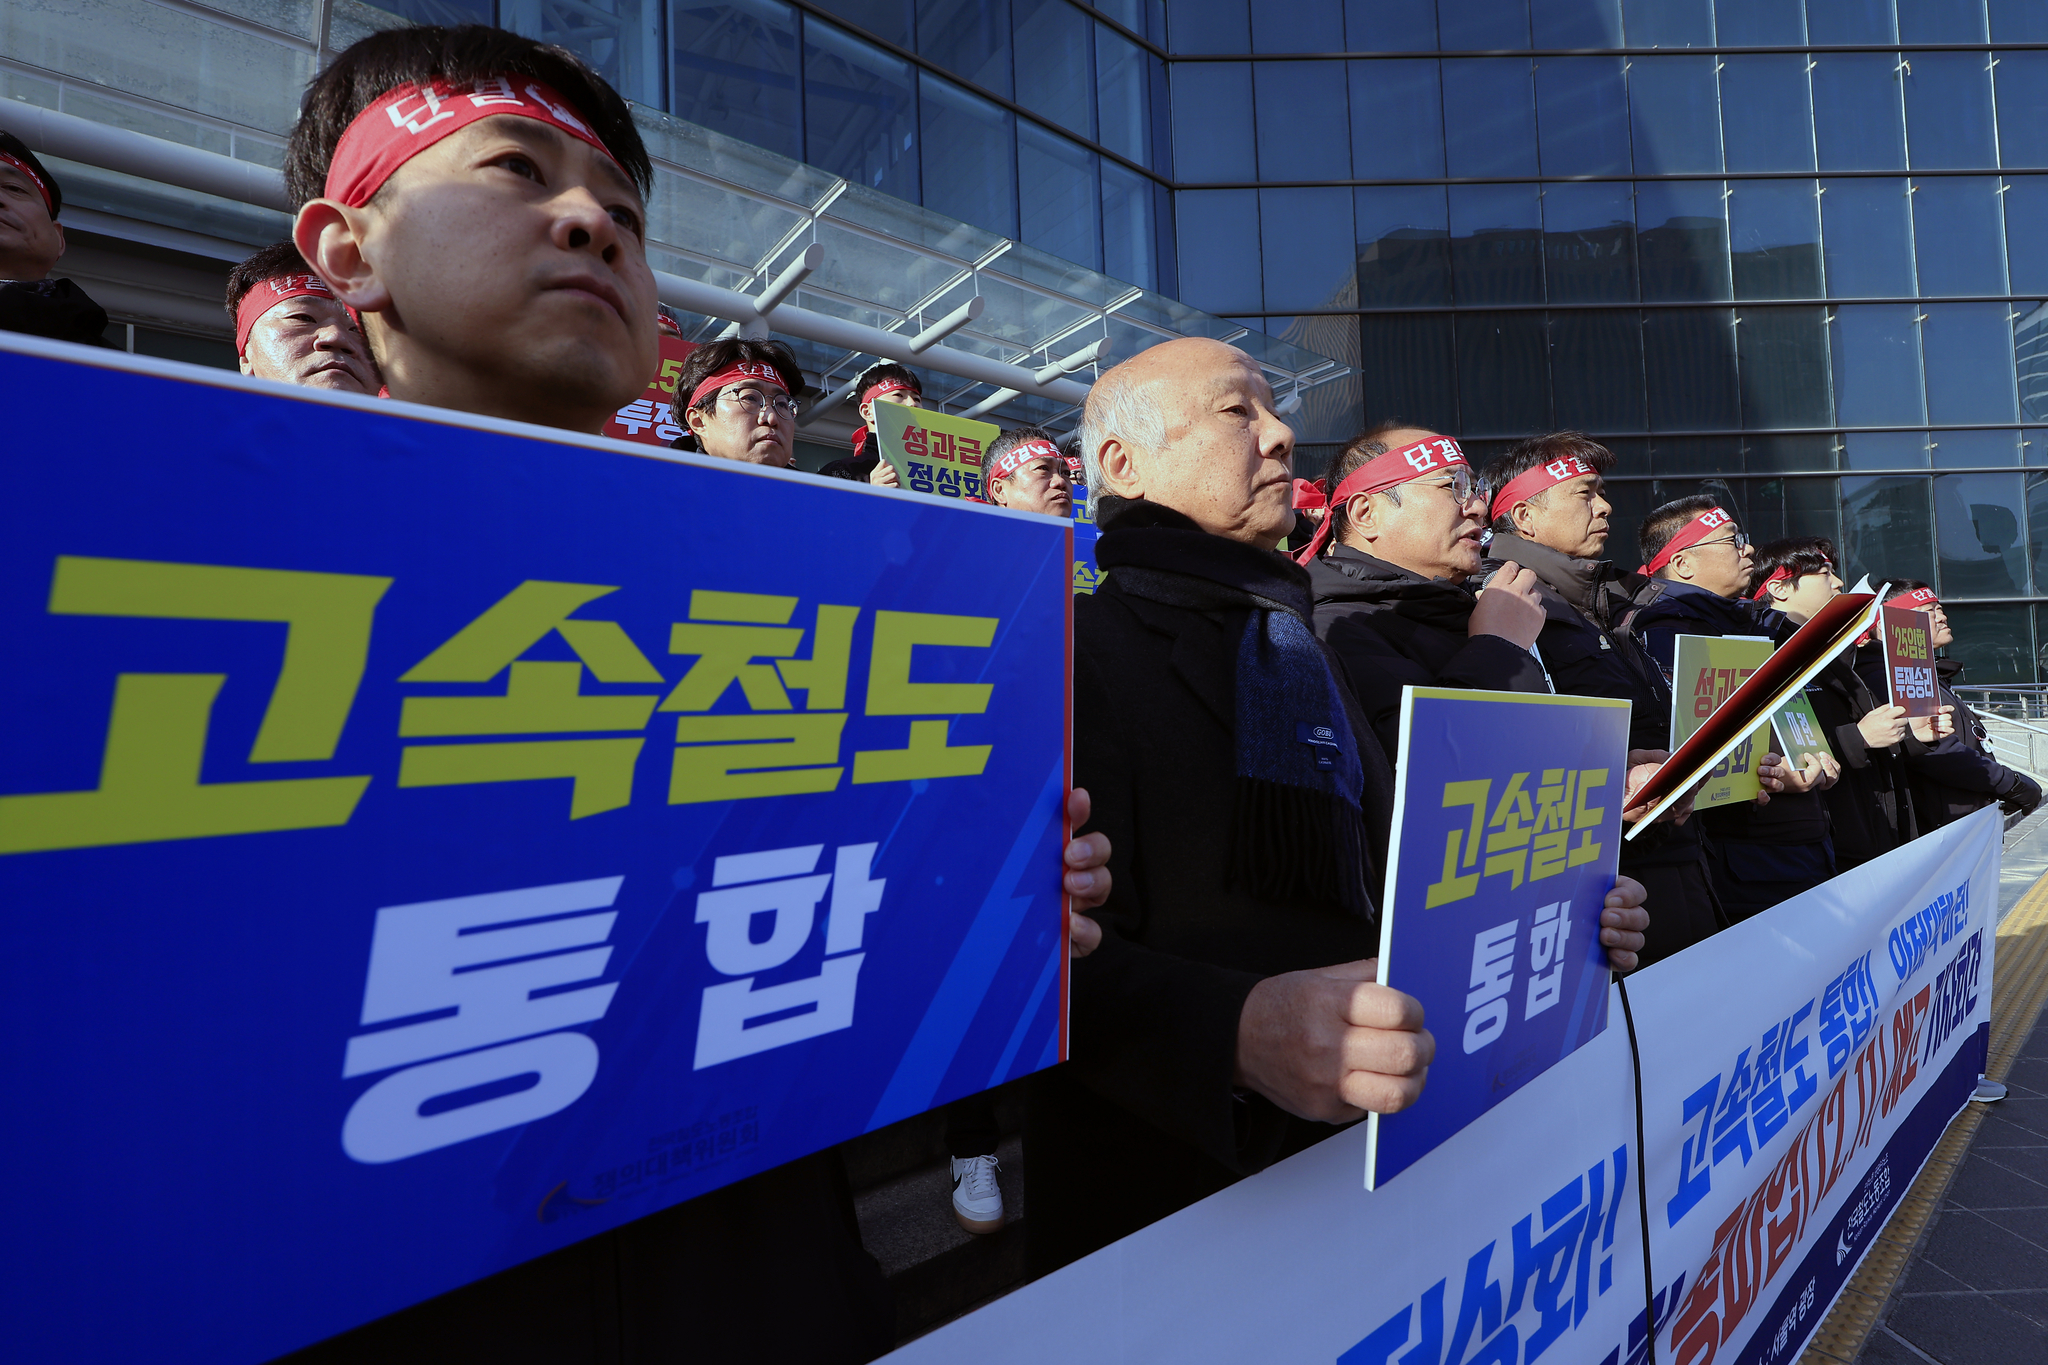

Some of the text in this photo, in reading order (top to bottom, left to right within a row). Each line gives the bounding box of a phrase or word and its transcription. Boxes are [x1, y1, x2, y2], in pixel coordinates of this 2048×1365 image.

[902, 425, 982, 467] 성과급
[1000, 445, 1034, 472] 단결
[1403, 438, 1462, 473] 단결
[1545, 456, 1590, 480] 단결
[1699, 507, 1731, 528] 단결
[1891, 624, 1928, 660] '25임협
[0, 554, 1000, 856] 고속철도
[1694, 668, 1757, 718] 성과
[1894, 666, 1935, 699] 투쟁승리
[1425, 768, 1609, 910] 고속철도
[1881, 983, 1931, 1119] 예고
[1922, 927, 1984, 1069] 기자회견
[1667, 997, 1818, 1229] 고속철도
[1820, 949, 1879, 1081] 통합!
[1847, 1165, 1891, 1240] 전국철도노동조합
[1770, 1275, 1816, 1362] 서울역 광장
